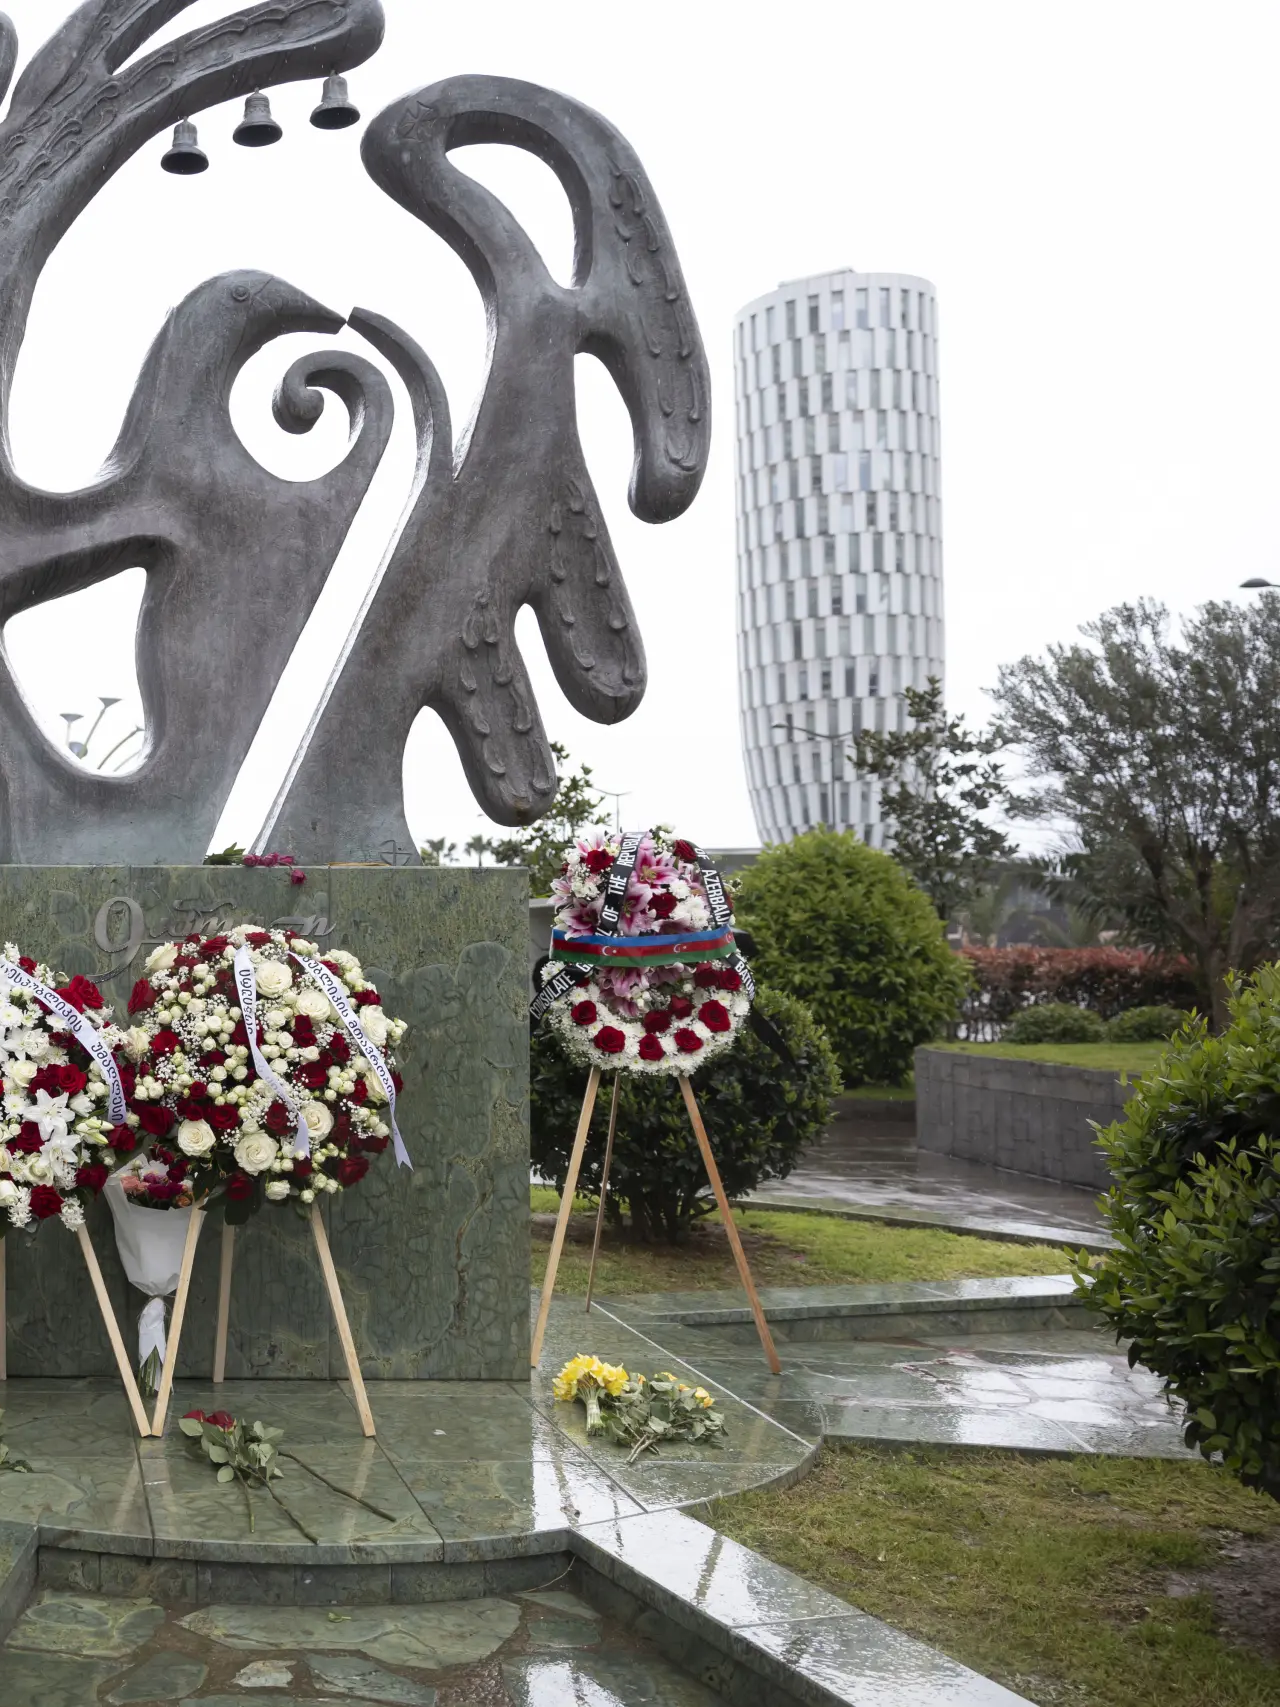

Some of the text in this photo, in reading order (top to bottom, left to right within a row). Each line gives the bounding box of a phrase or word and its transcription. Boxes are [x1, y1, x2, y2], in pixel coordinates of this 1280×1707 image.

[608, 872, 627, 896] THE
[603, 903, 619, 923] OF
[530, 970, 577, 1018] CONSULATE
[90, 1041, 126, 1122] უმაღლესი
